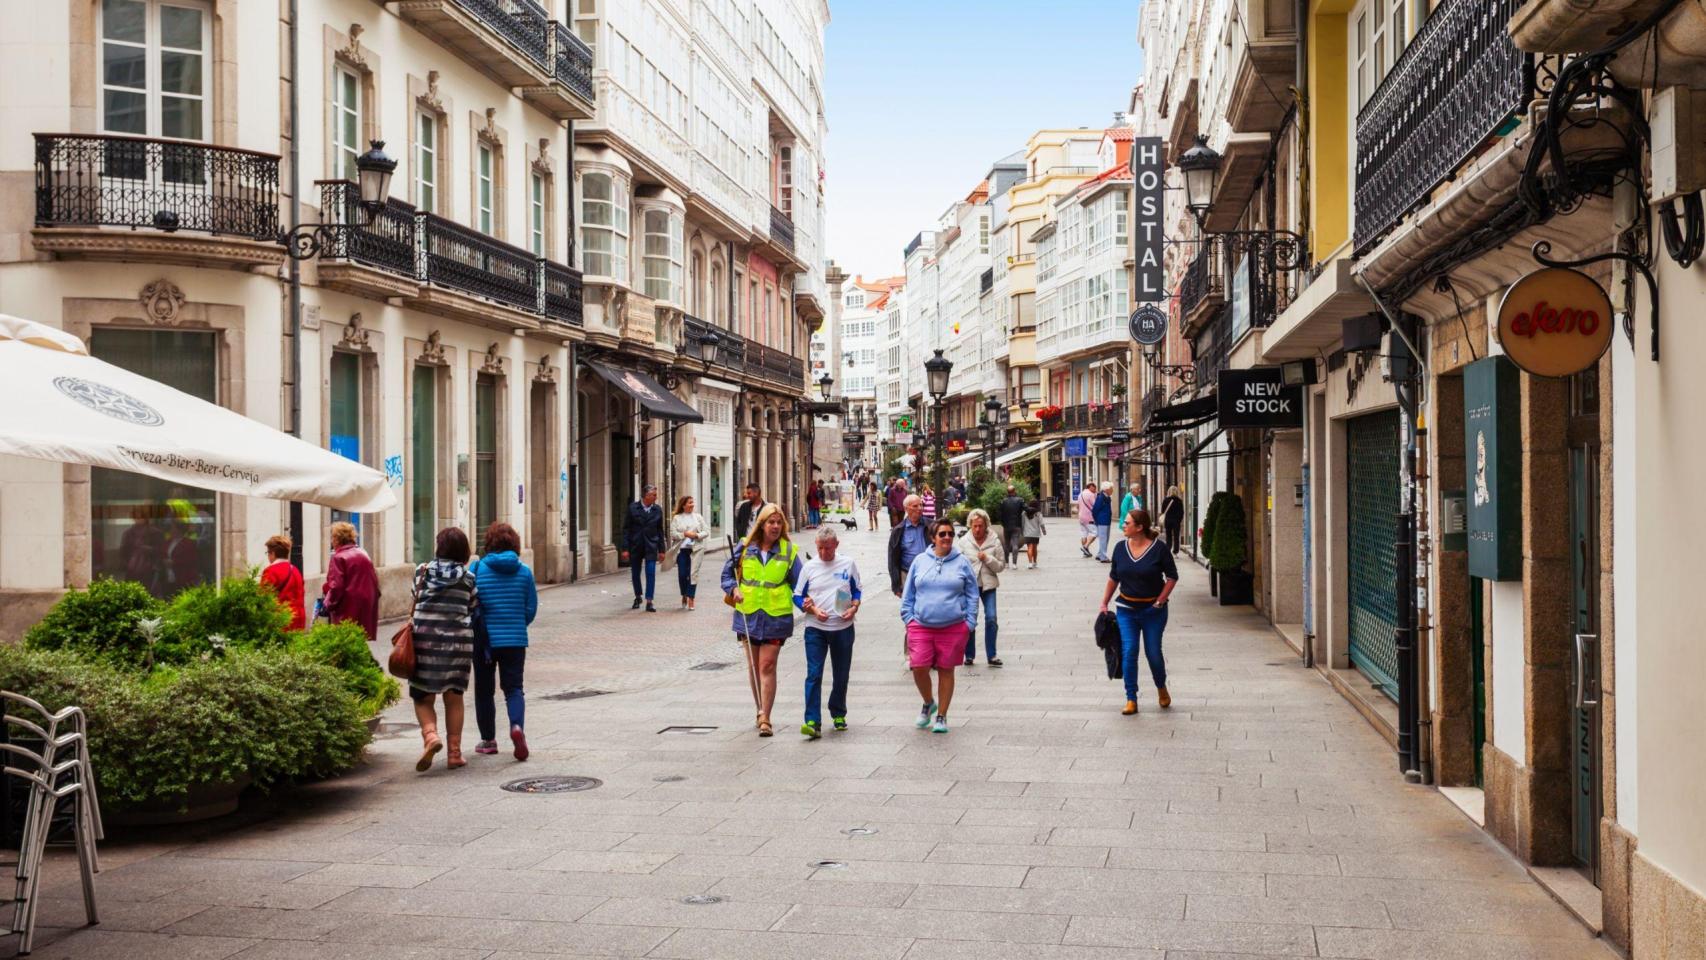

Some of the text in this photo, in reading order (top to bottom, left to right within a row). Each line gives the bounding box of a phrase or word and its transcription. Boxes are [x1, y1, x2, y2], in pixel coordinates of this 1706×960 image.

[1139, 144, 1158, 294] HOSTAL
[1244, 382, 1281, 396] NEW
[1235, 399, 1291, 413] STOCK
